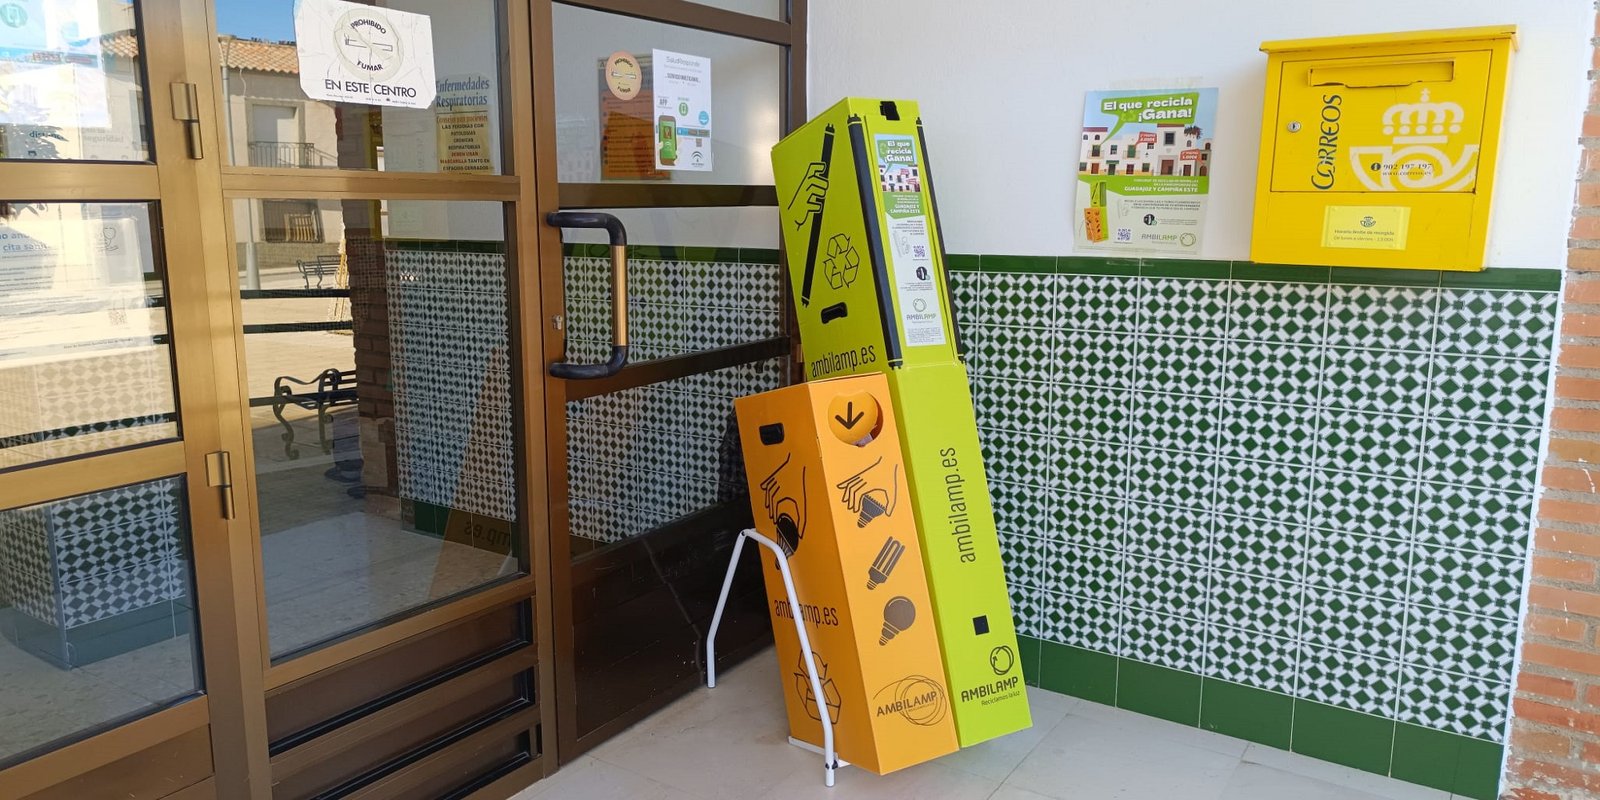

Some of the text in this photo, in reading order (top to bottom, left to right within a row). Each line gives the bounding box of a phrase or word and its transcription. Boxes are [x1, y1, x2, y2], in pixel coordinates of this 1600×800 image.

[350, 19, 387, 34] PROHIBIDO
[357, 60, 384, 72] FUMAR
[325, 79, 417, 98] EN ESTE CENTRO
[436, 76, 490, 93] Enfermedades
[436, 92, 488, 111] Respiratorias
[1103, 97, 1192, 112] El que recicla
[1138, 109, 1192, 123] ¡Gana!
[887, 147, 912, 155] recicla
[897, 141, 911, 149] que
[1311, 94, 1342, 190] CORREOS
[884, 154, 914, 163] ¡Gana!
[811, 345, 876, 378] ambilamp.es
[940, 447, 977, 563] ambilamp.es
[774, 597, 839, 629] ambamp.es
[961, 676, 1019, 703] AMBILAMP
[876, 691, 937, 717] AMBILAMP
